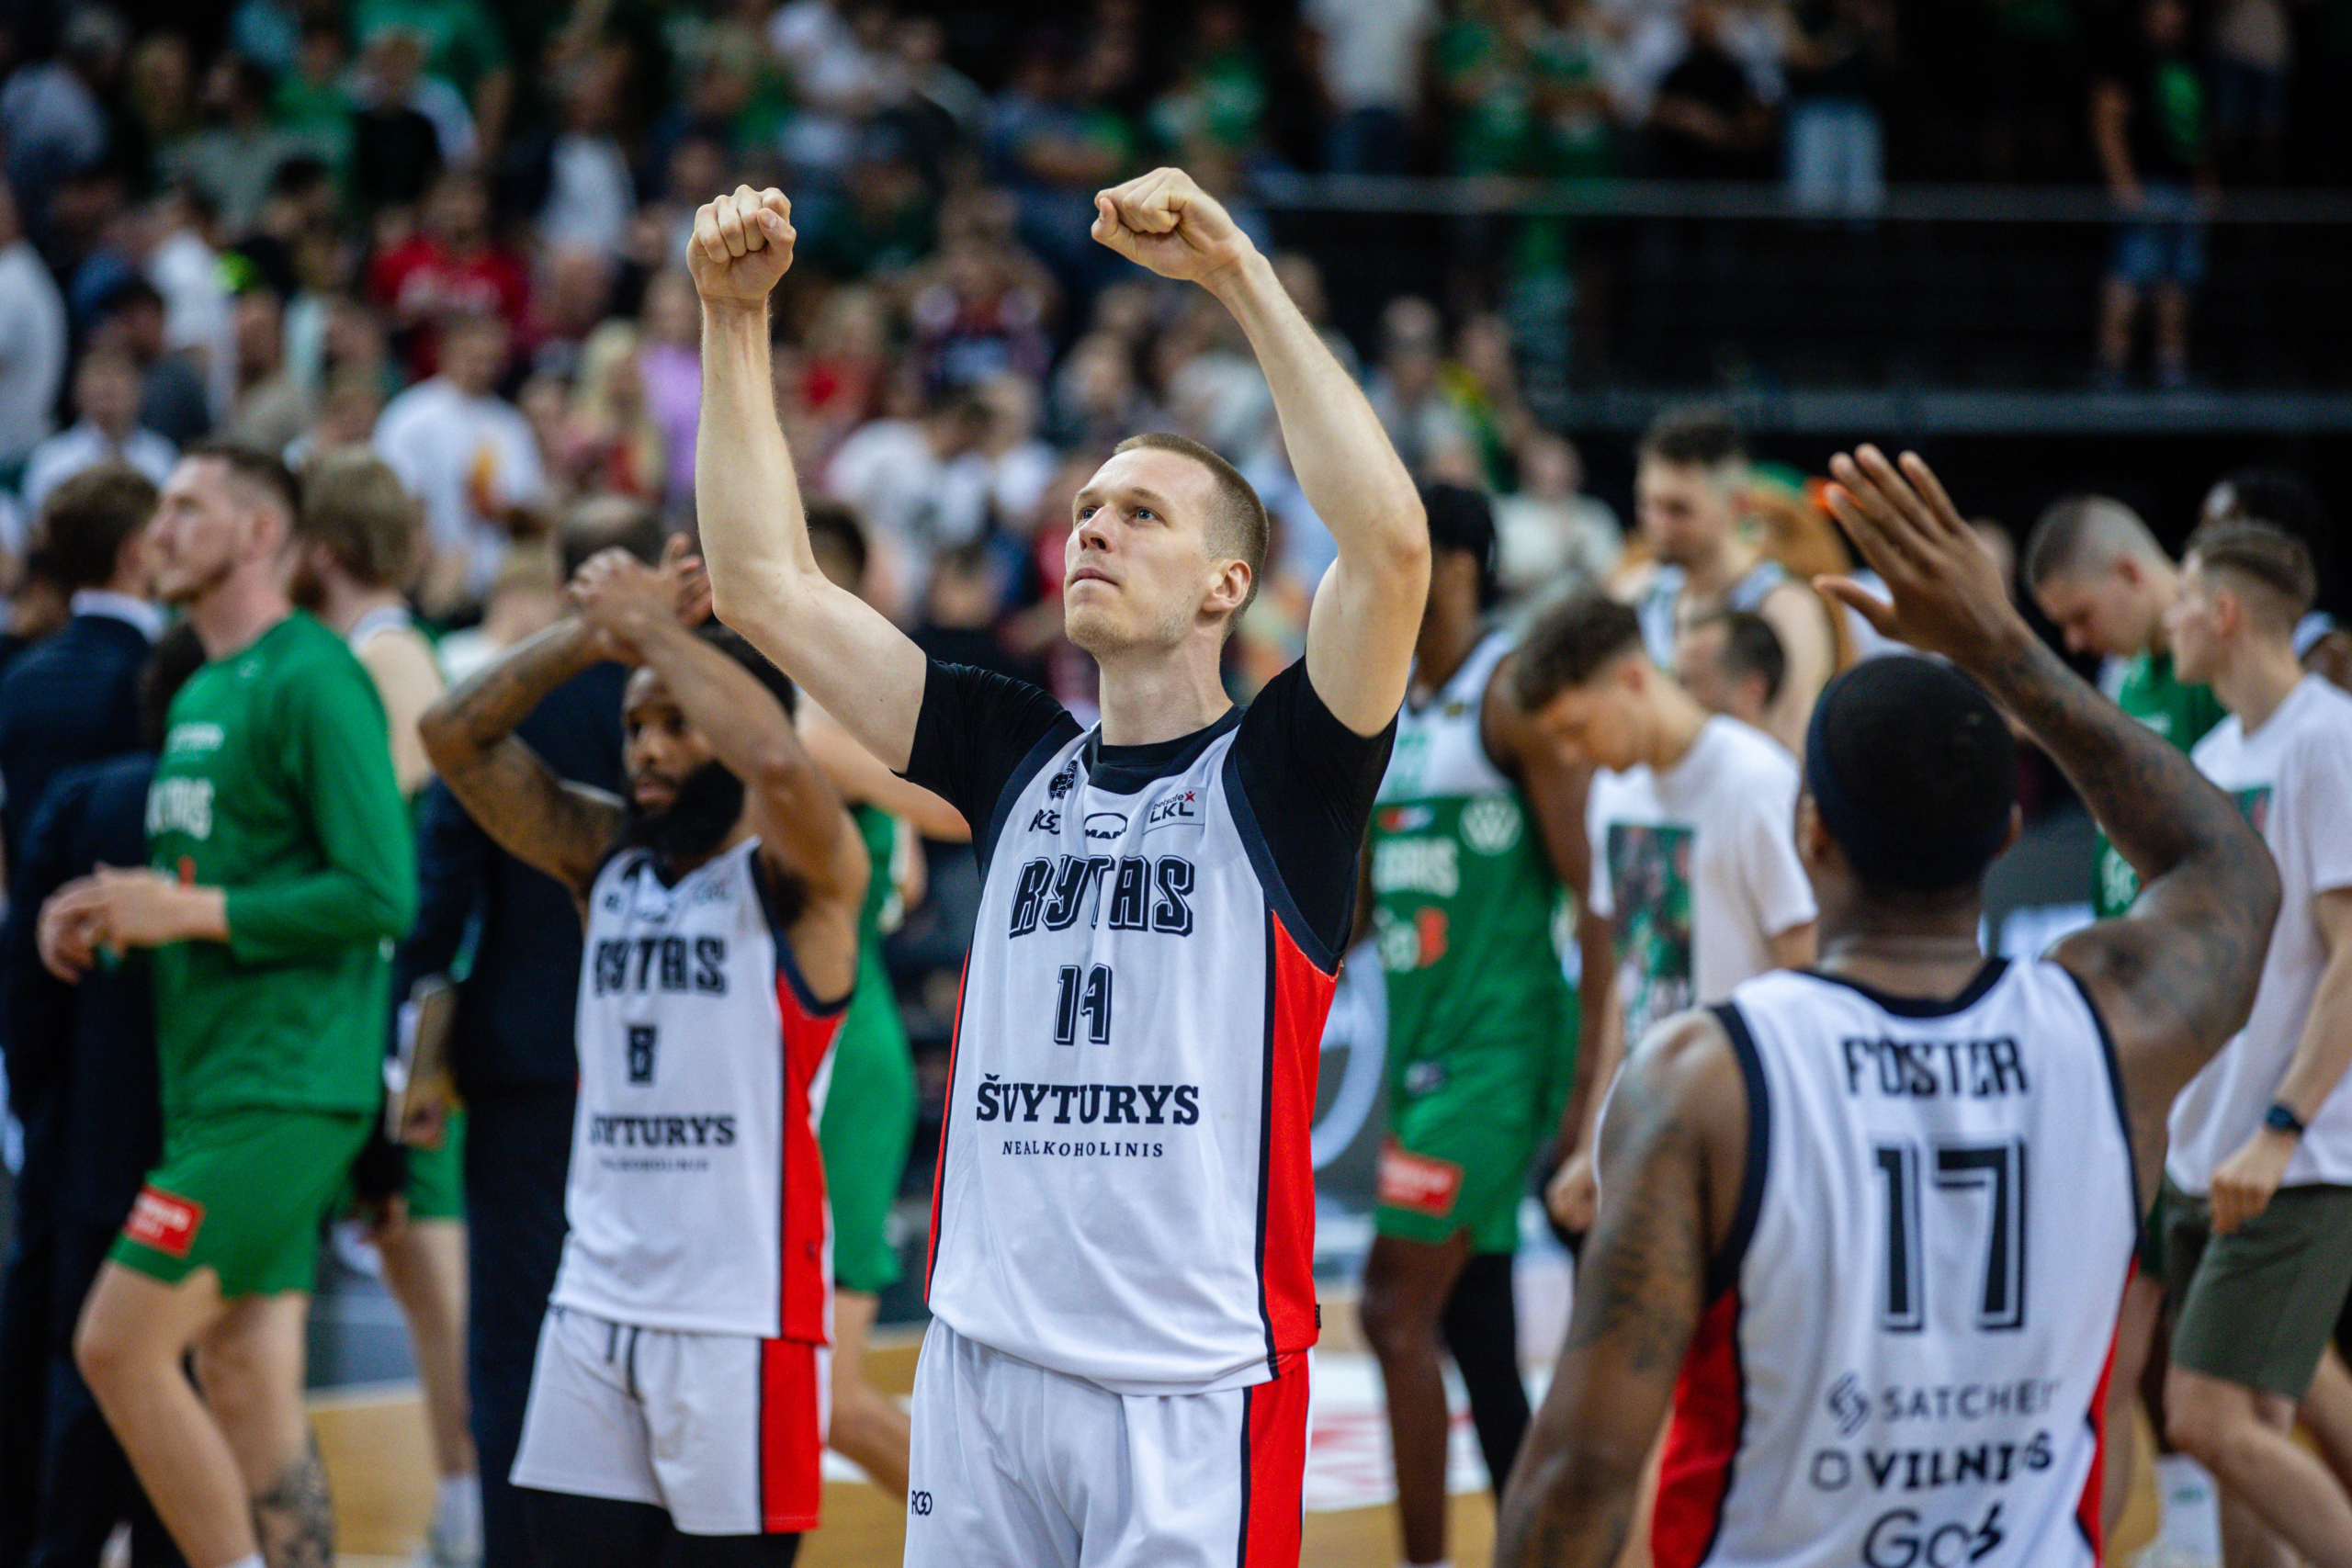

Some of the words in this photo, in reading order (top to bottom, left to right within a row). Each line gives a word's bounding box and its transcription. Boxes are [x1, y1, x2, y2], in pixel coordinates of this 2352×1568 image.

[1149, 801, 1194, 824] LKL
[1009, 854, 1195, 940] RYTAS
[1054, 963, 1113, 1046] 14
[1842, 1035, 2028, 1098] FOSTER
[977, 1073, 1199, 1125] ŠVYTURYS
[1002, 1141, 1163, 1157] NEALKOHOLINIS
[1875, 1139, 2026, 1332] 17
[1883, 1381, 2061, 1421] SATCHE
[1865, 1430, 2052, 1492] VILNIS
